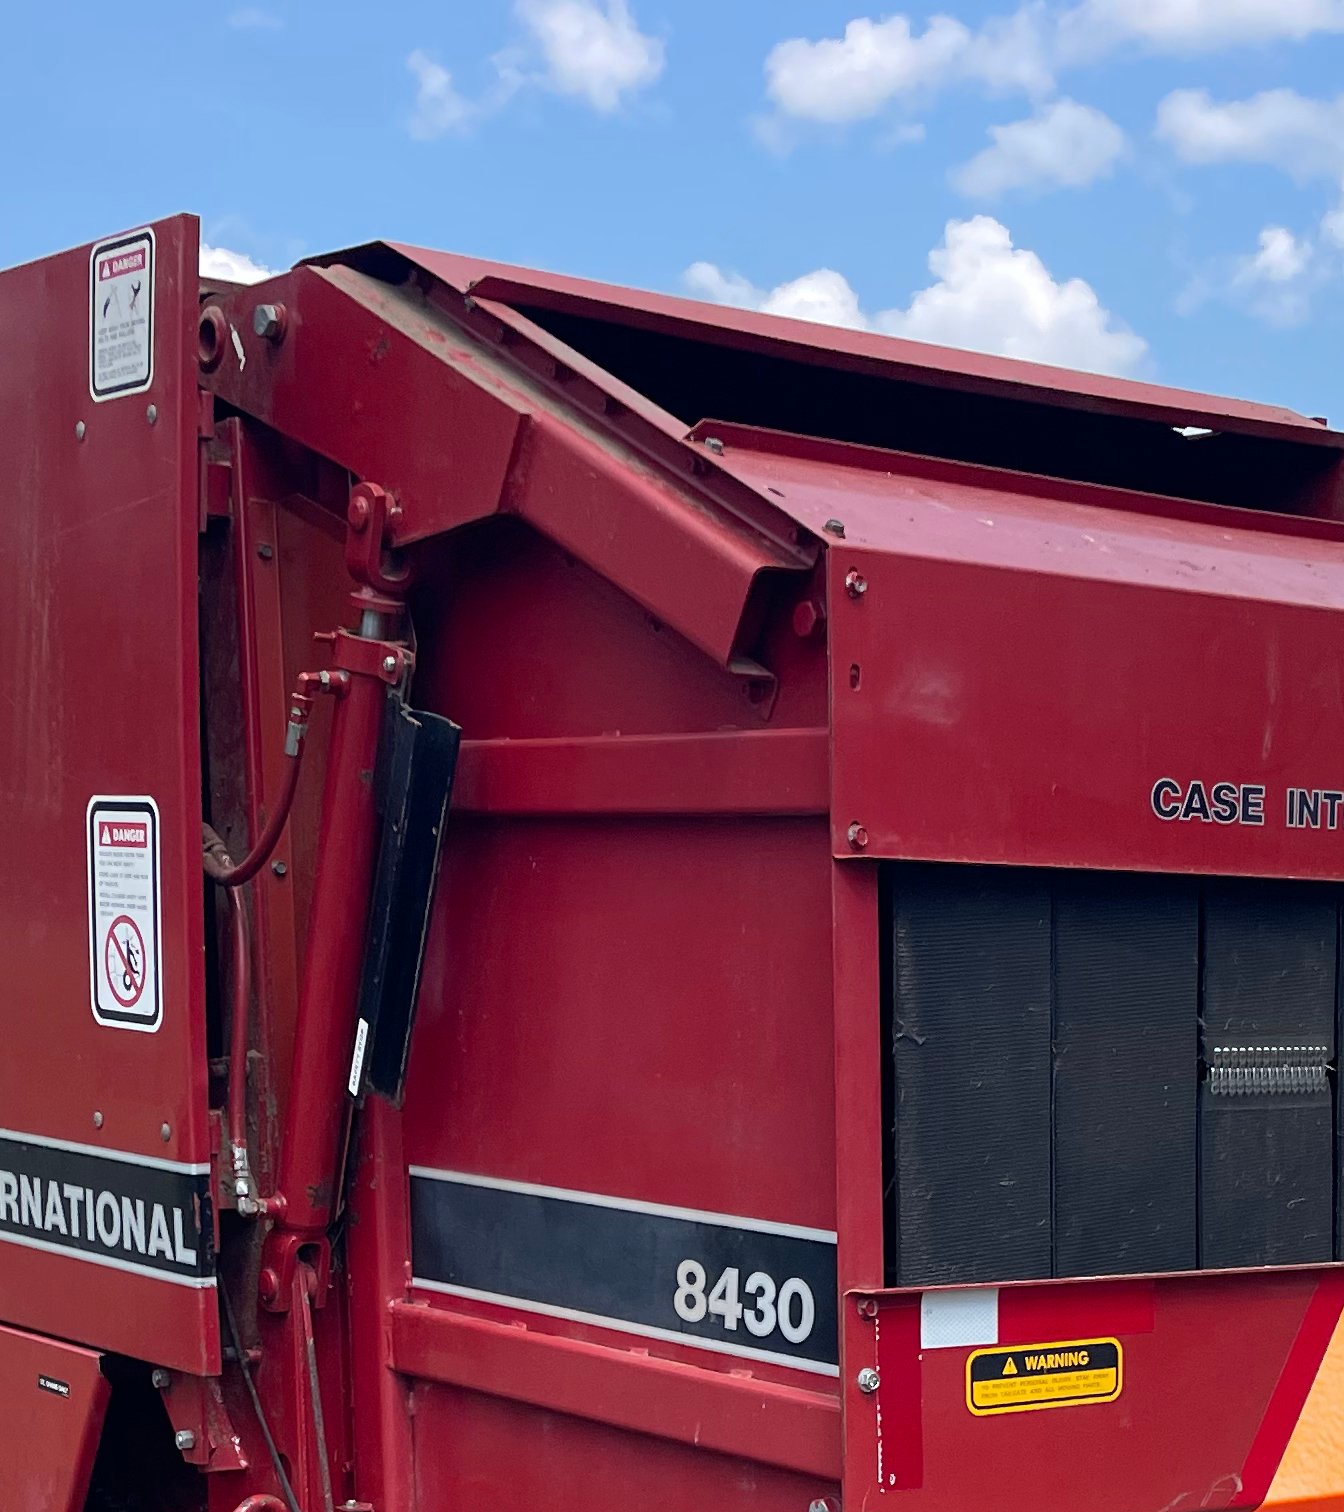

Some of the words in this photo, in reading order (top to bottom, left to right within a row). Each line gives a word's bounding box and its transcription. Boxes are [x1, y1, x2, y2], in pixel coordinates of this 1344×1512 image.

[112, 253, 143, 274] DANGER
[1151, 777, 1265, 826] CASE
[112, 828, 144, 843] DANGER
[674, 1259, 815, 1344] 8430
[1024, 1350, 1090, 1371] WARNING
